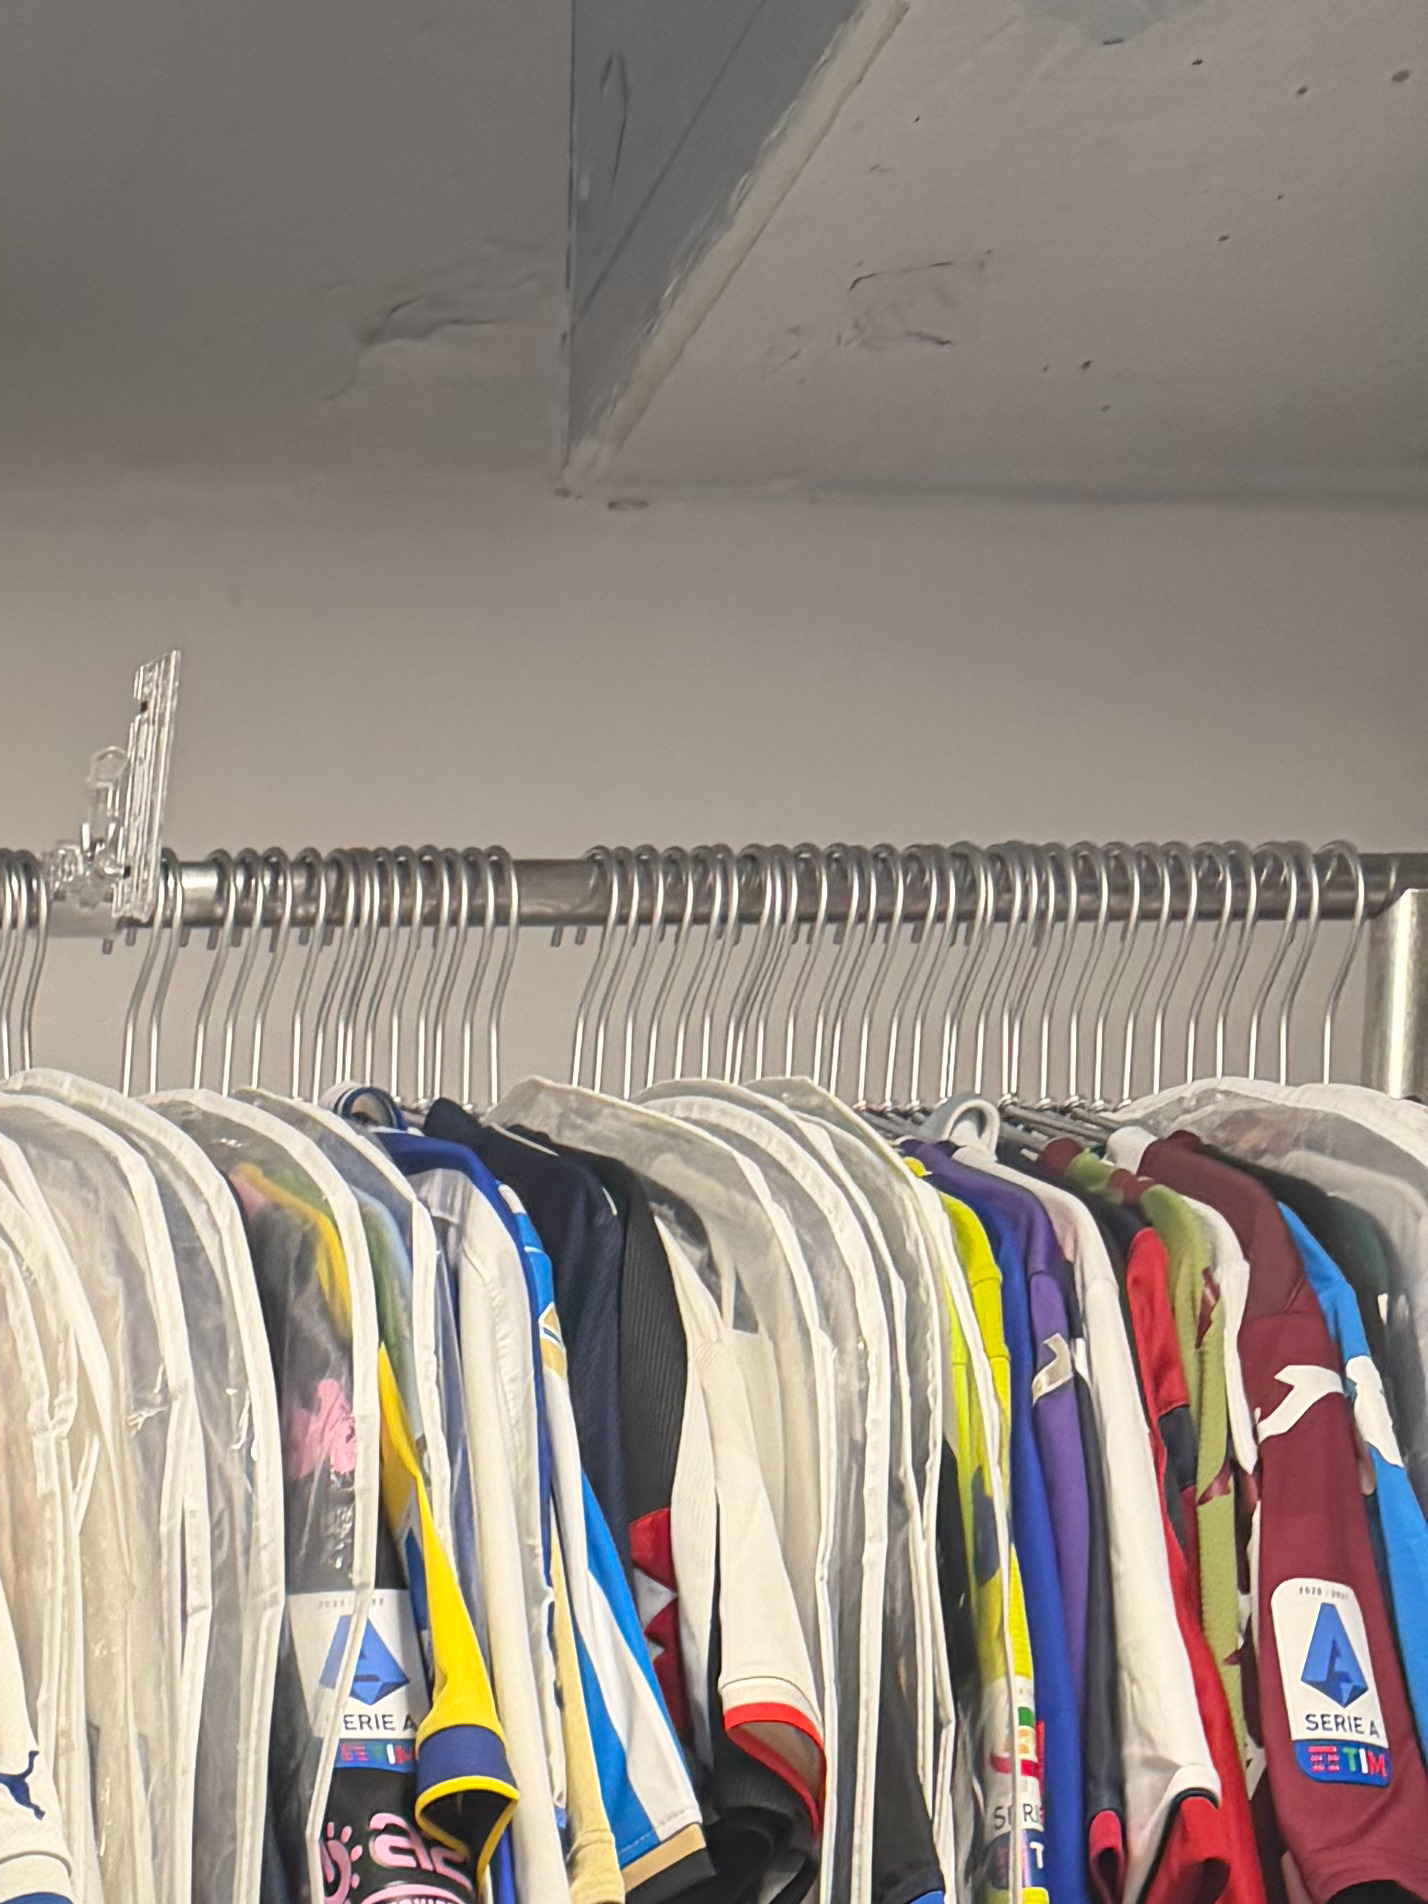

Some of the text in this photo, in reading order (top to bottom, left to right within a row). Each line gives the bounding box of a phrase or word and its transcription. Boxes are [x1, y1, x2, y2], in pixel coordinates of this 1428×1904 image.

[1305, 1712, 1380, 1739] SERIE A
[1342, 1746, 1387, 1777] TIM
